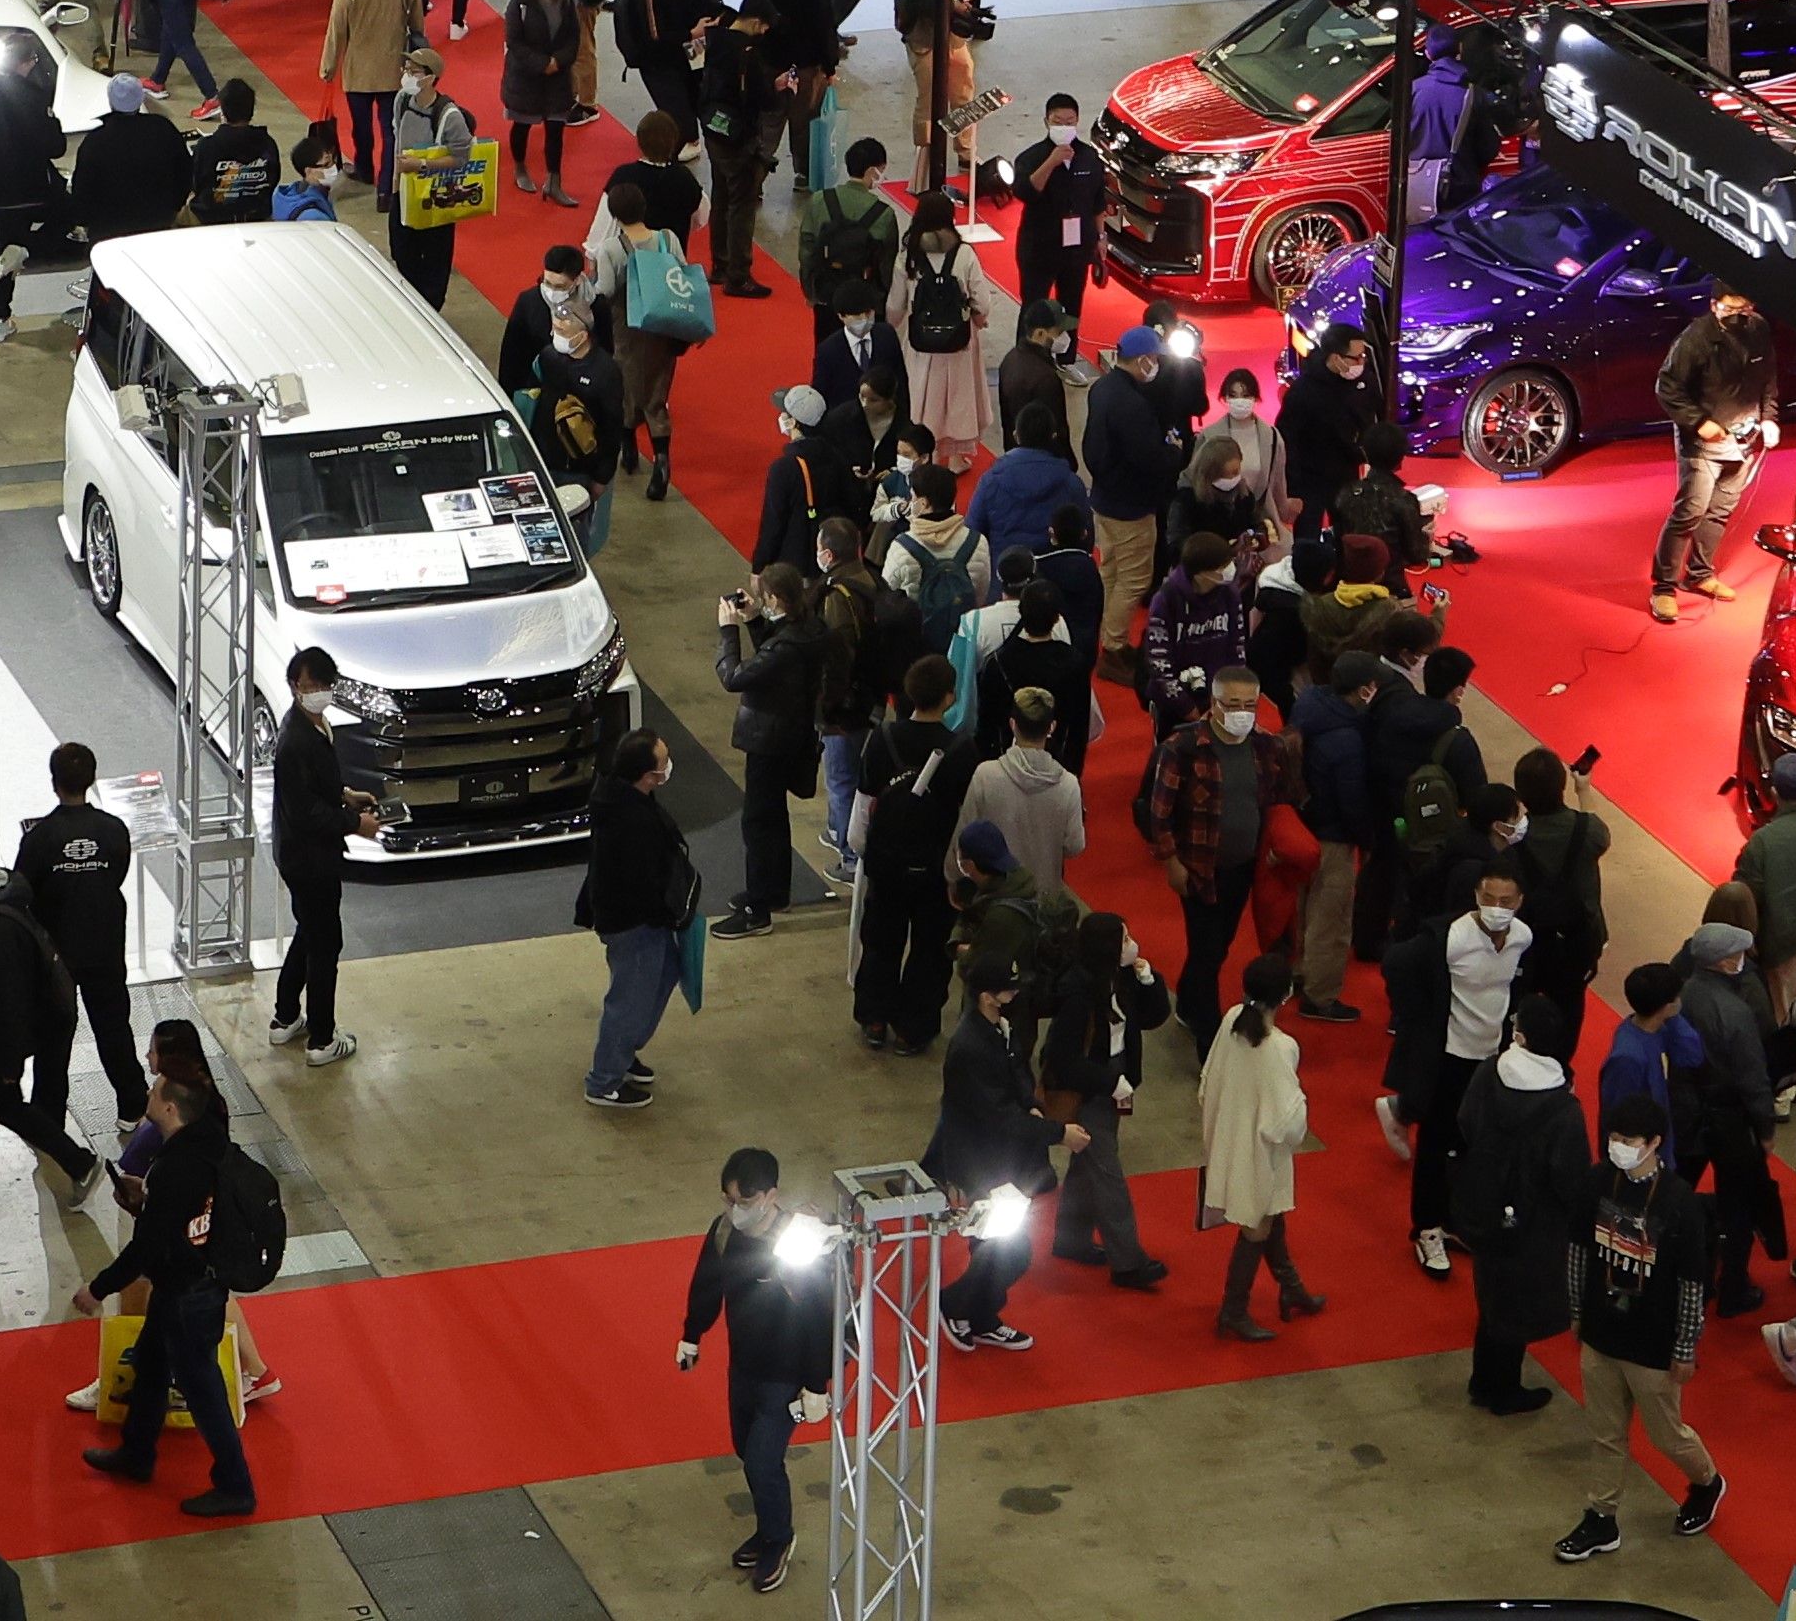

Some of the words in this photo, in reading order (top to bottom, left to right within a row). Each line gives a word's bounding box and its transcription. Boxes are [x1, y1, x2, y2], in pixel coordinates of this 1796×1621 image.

[1637, 167, 1679, 208] IZAWA
[1679, 194, 1708, 226] ART
[1707, 213, 1762, 259] DESIGN
[361, 437, 430, 452] ROHAN
[429, 436, 454, 445] Body
[454, 432, 480, 443] Work
[52, 860, 109, 872] ROHAN
